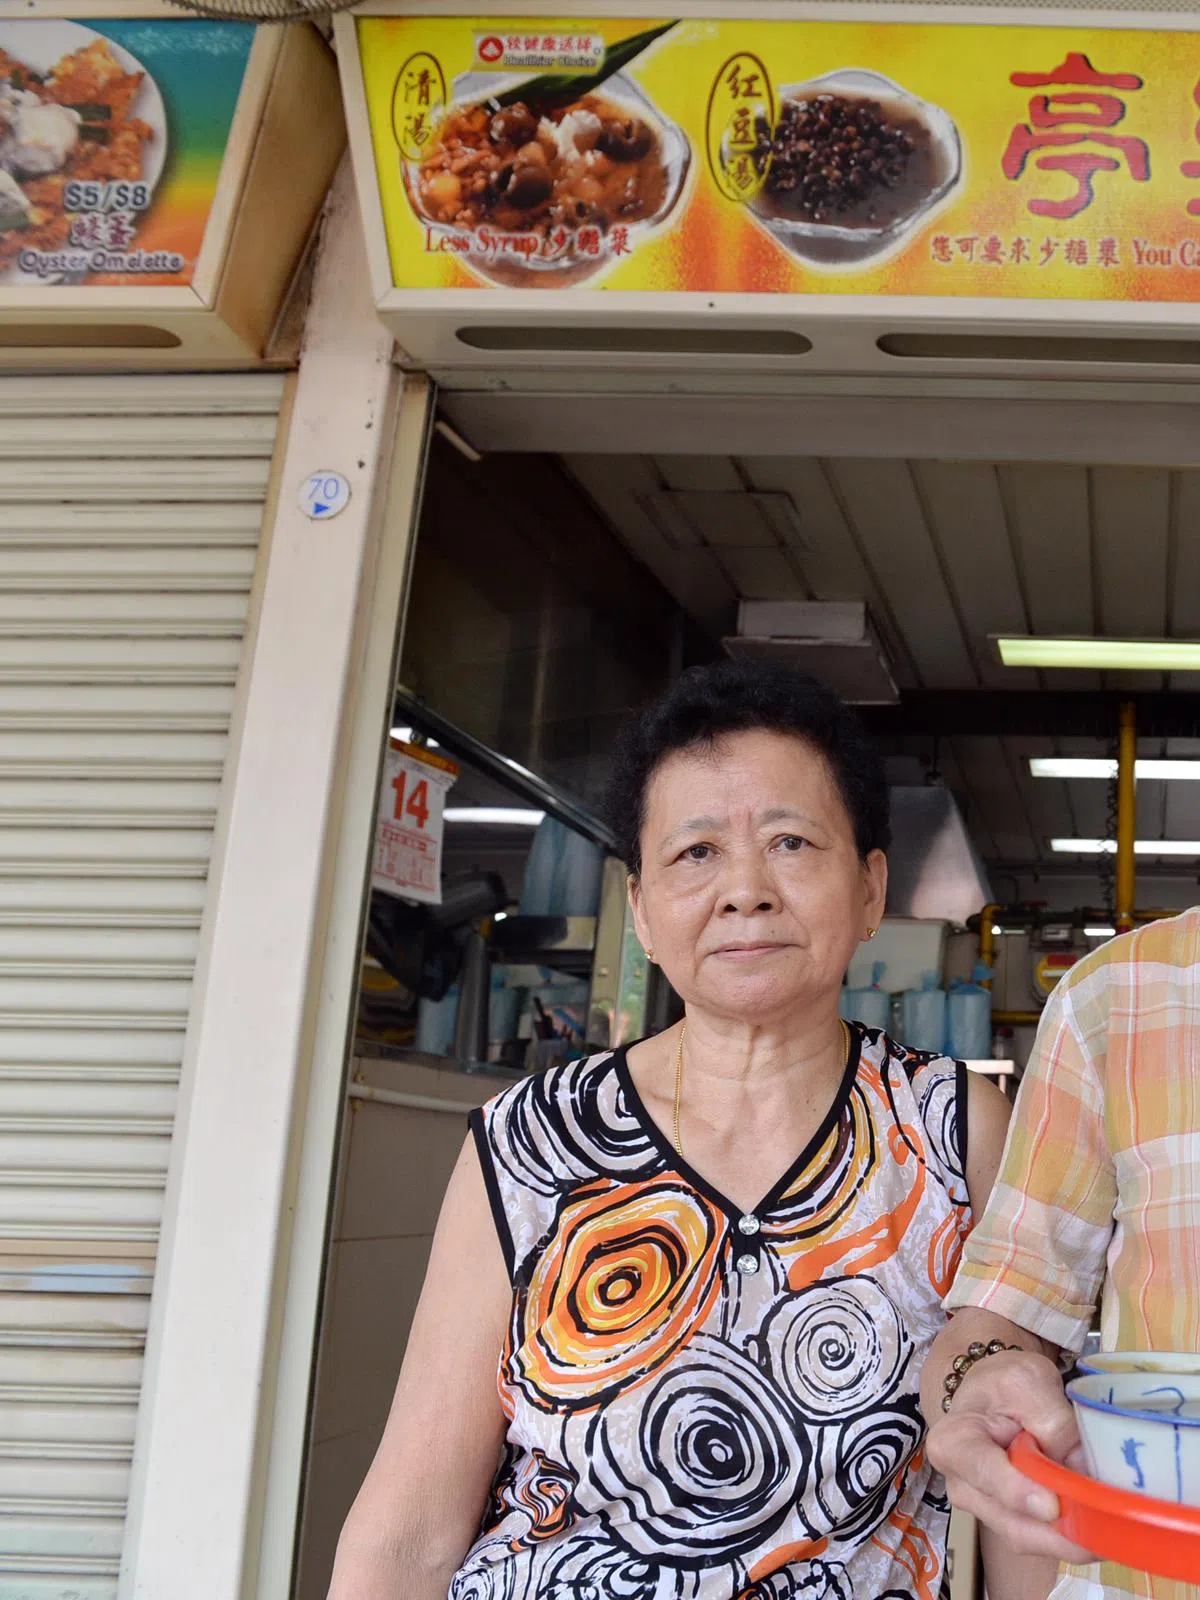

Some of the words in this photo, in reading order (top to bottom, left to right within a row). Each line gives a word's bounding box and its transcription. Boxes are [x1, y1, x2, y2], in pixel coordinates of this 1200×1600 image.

[424, 225, 470, 253] Less
[476, 227, 540, 263] Syrup
[1133, 240, 1172, 266] You
[21, 251, 86, 276] Oyster
[92, 250, 181, 269] Omelette
[308, 479, 339, 500] 70
[391, 769, 430, 830] 14
